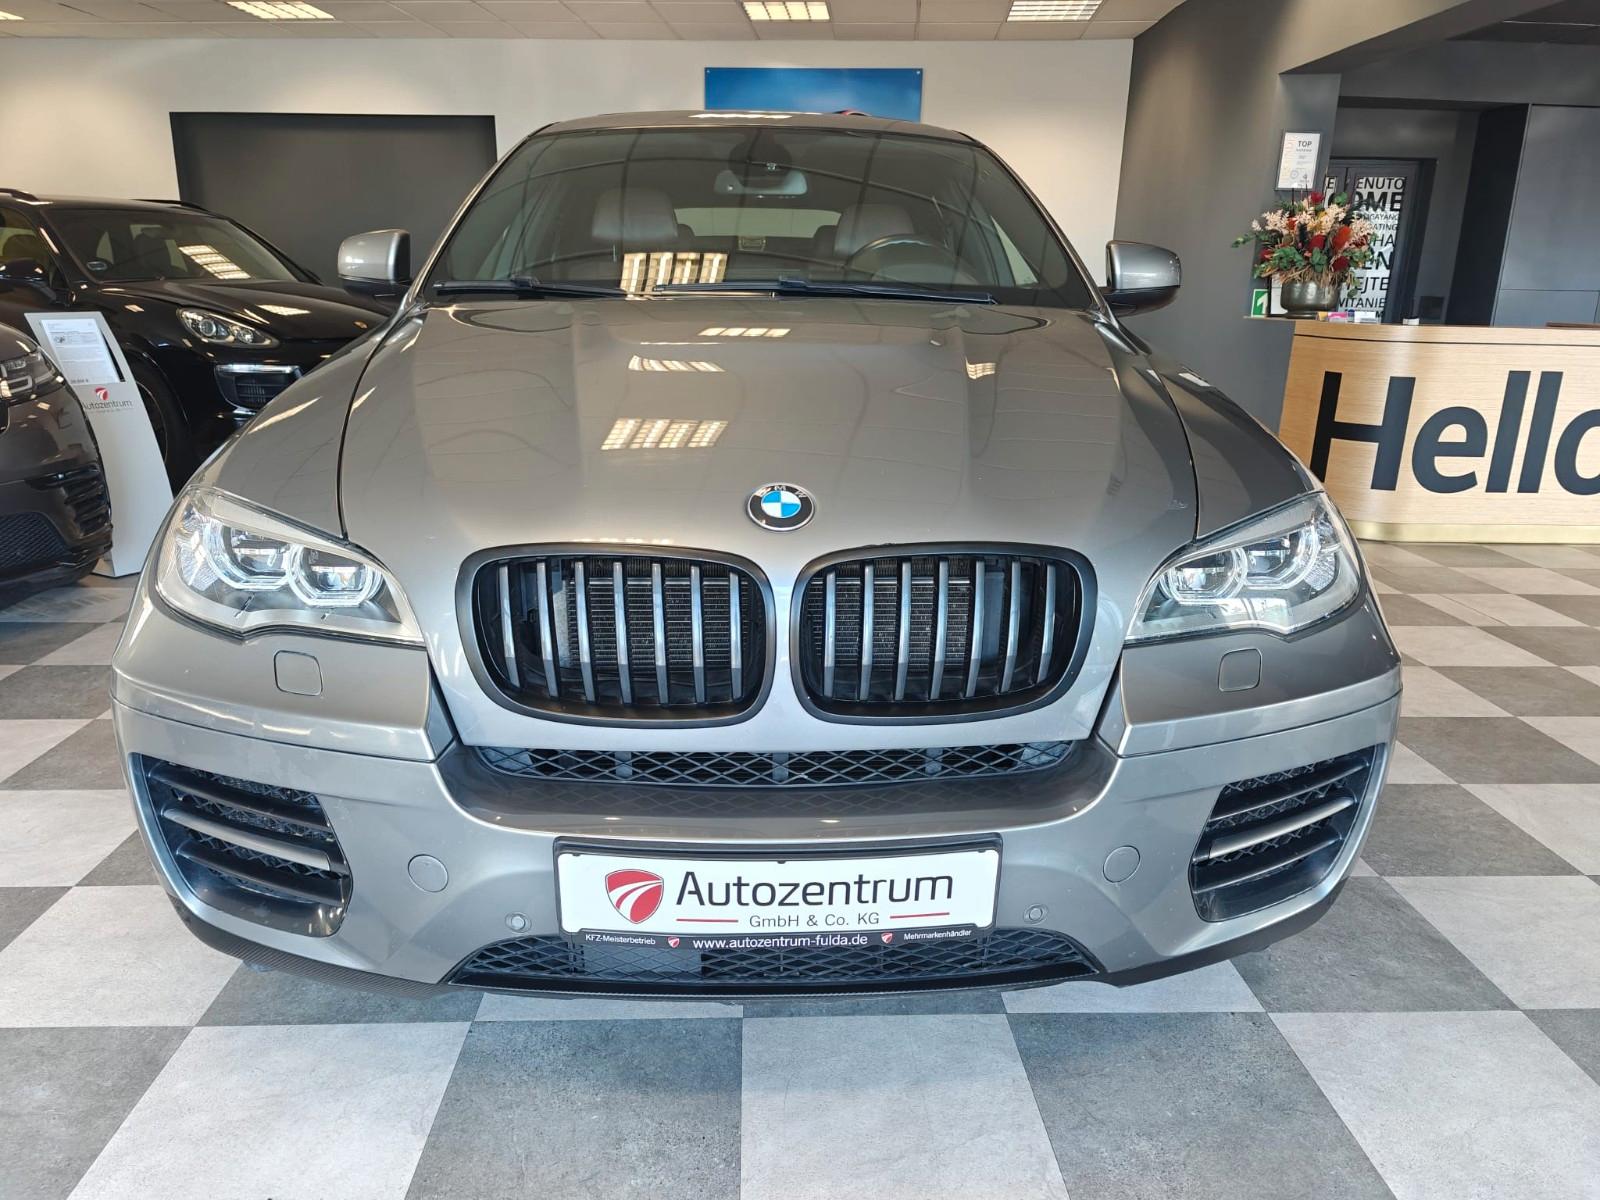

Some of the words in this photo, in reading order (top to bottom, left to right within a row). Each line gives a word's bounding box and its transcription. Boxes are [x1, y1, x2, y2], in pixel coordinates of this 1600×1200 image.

[1309, 370, 1600, 496] Hello
[675, 871, 953, 907] Autozentrum
[749, 914, 799, 928] GmbH
[806, 914, 818, 927] &
[825, 913, 849, 926] Co.
[858, 912, 880, 925] KG
[585, 934, 656, 945] KFZ-Meisterbetrieb
[692, 934, 868, 950] www.autozentrum-fulda.de
[903, 929, 972, 941] Mehrmarkenhändler
